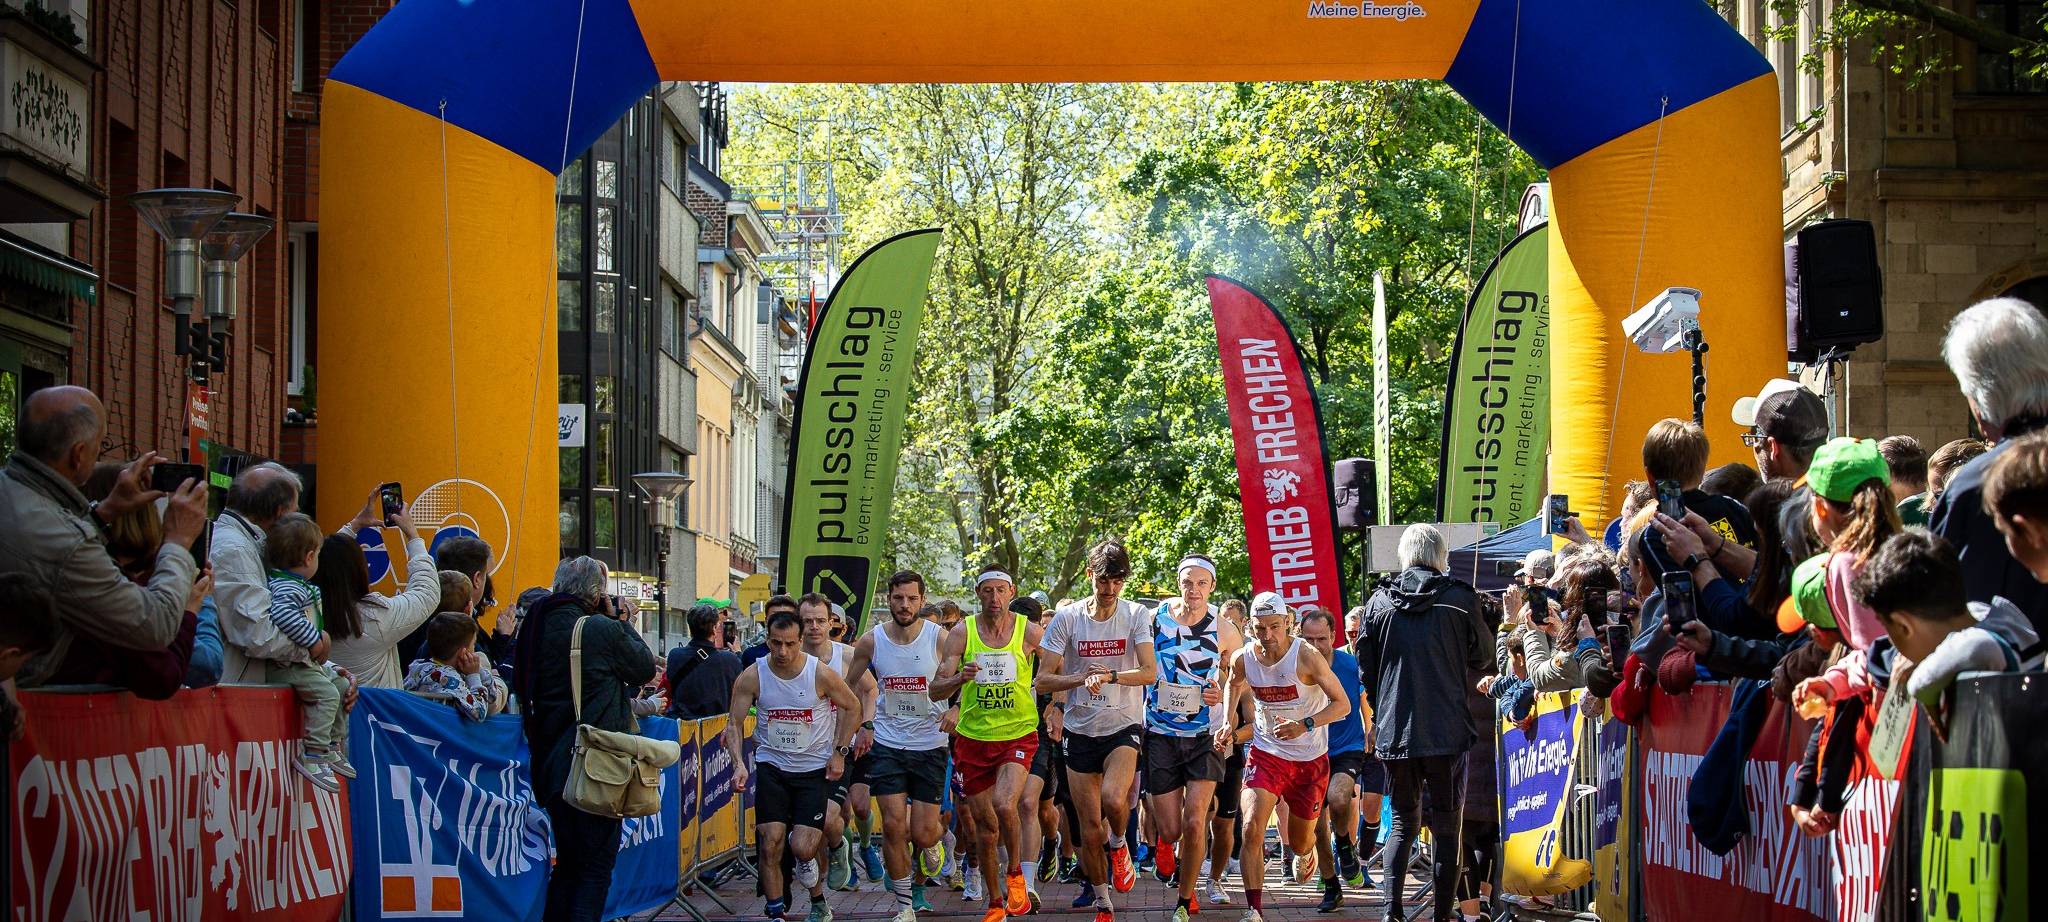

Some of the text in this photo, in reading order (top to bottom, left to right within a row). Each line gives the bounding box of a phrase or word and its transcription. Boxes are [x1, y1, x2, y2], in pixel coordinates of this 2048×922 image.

[1309, 2, 1425, 20] Meine Energie.
[880, 310, 902, 372] service
[1239, 338, 1300, 463] FRECHEN
[811, 306, 885, 544] pulsschlag
[864, 388, 890, 480] marketing
[1515, 374, 1542, 466] marketing
[857, 496, 873, 544] event
[1090, 640, 1119, 649] MILERS
[1090, 648, 1125, 656] COLONIA
[893, 683, 926, 691] COLONIA
[976, 687, 1014, 699] LAUF
[976, 699, 1014, 709] TEAM
